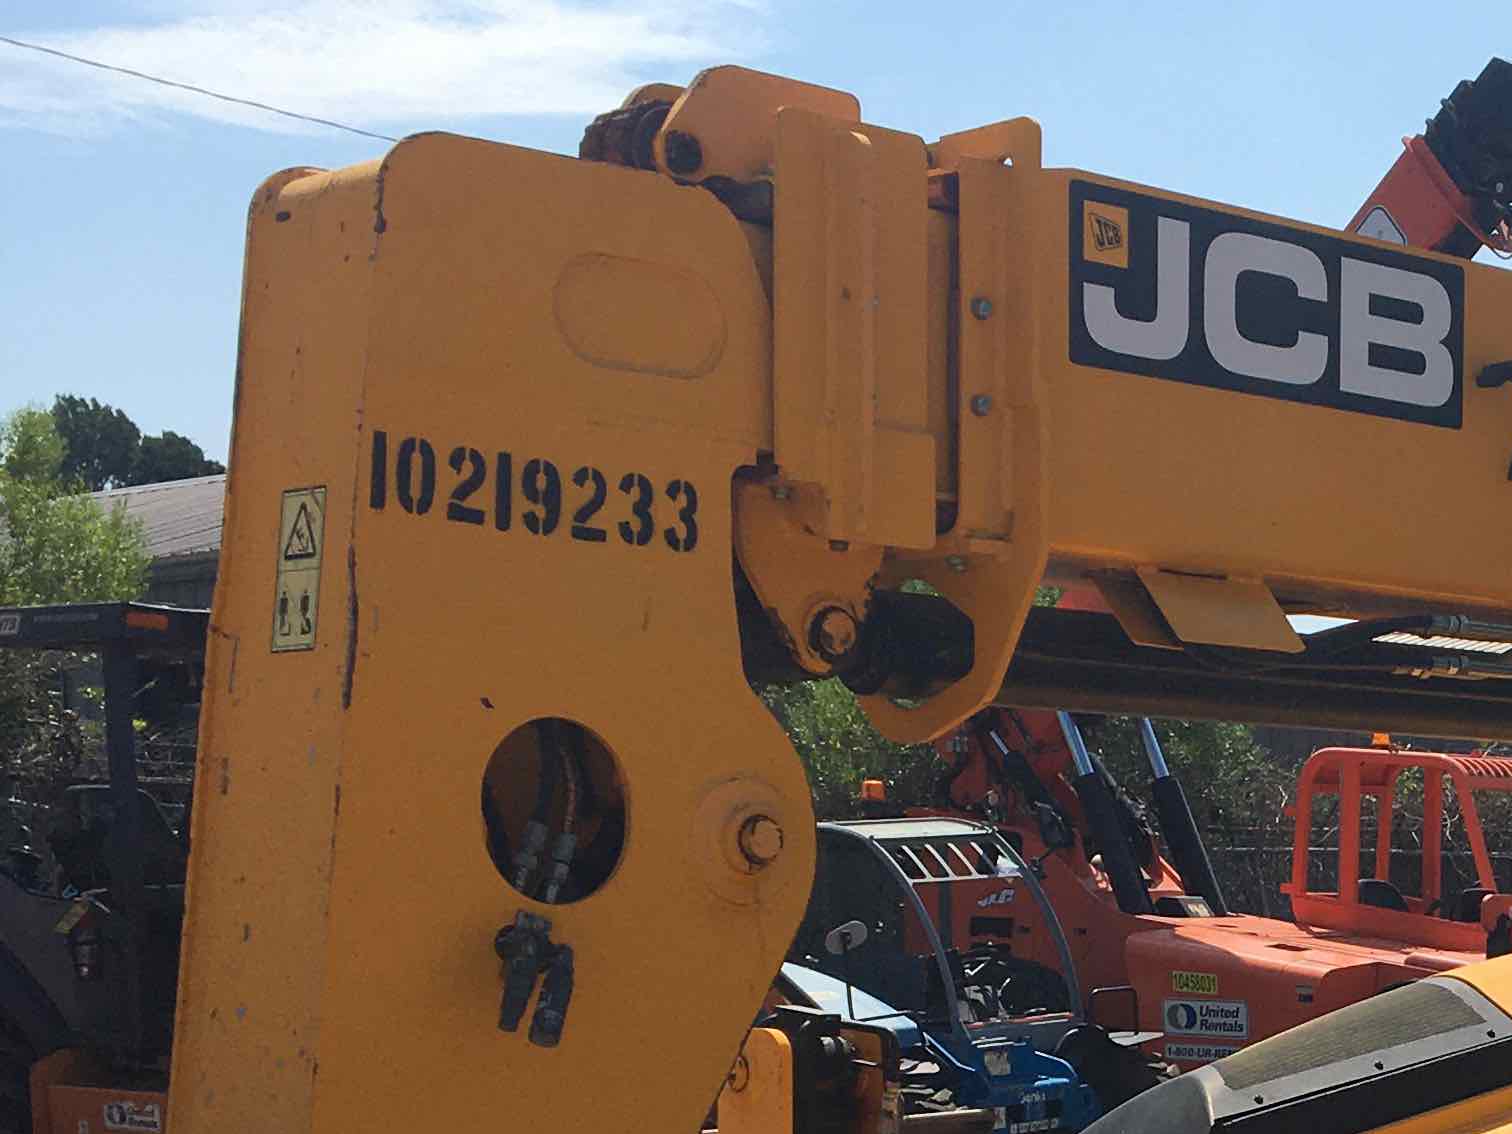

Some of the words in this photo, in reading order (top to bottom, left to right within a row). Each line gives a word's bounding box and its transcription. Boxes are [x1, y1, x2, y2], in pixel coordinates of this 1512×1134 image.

[1083, 215, 1454, 408] JCB
[369, 430, 698, 552] 10219233
[1199, 1005, 1240, 1019] United
[1199, 1020, 1244, 1033] Rentals
